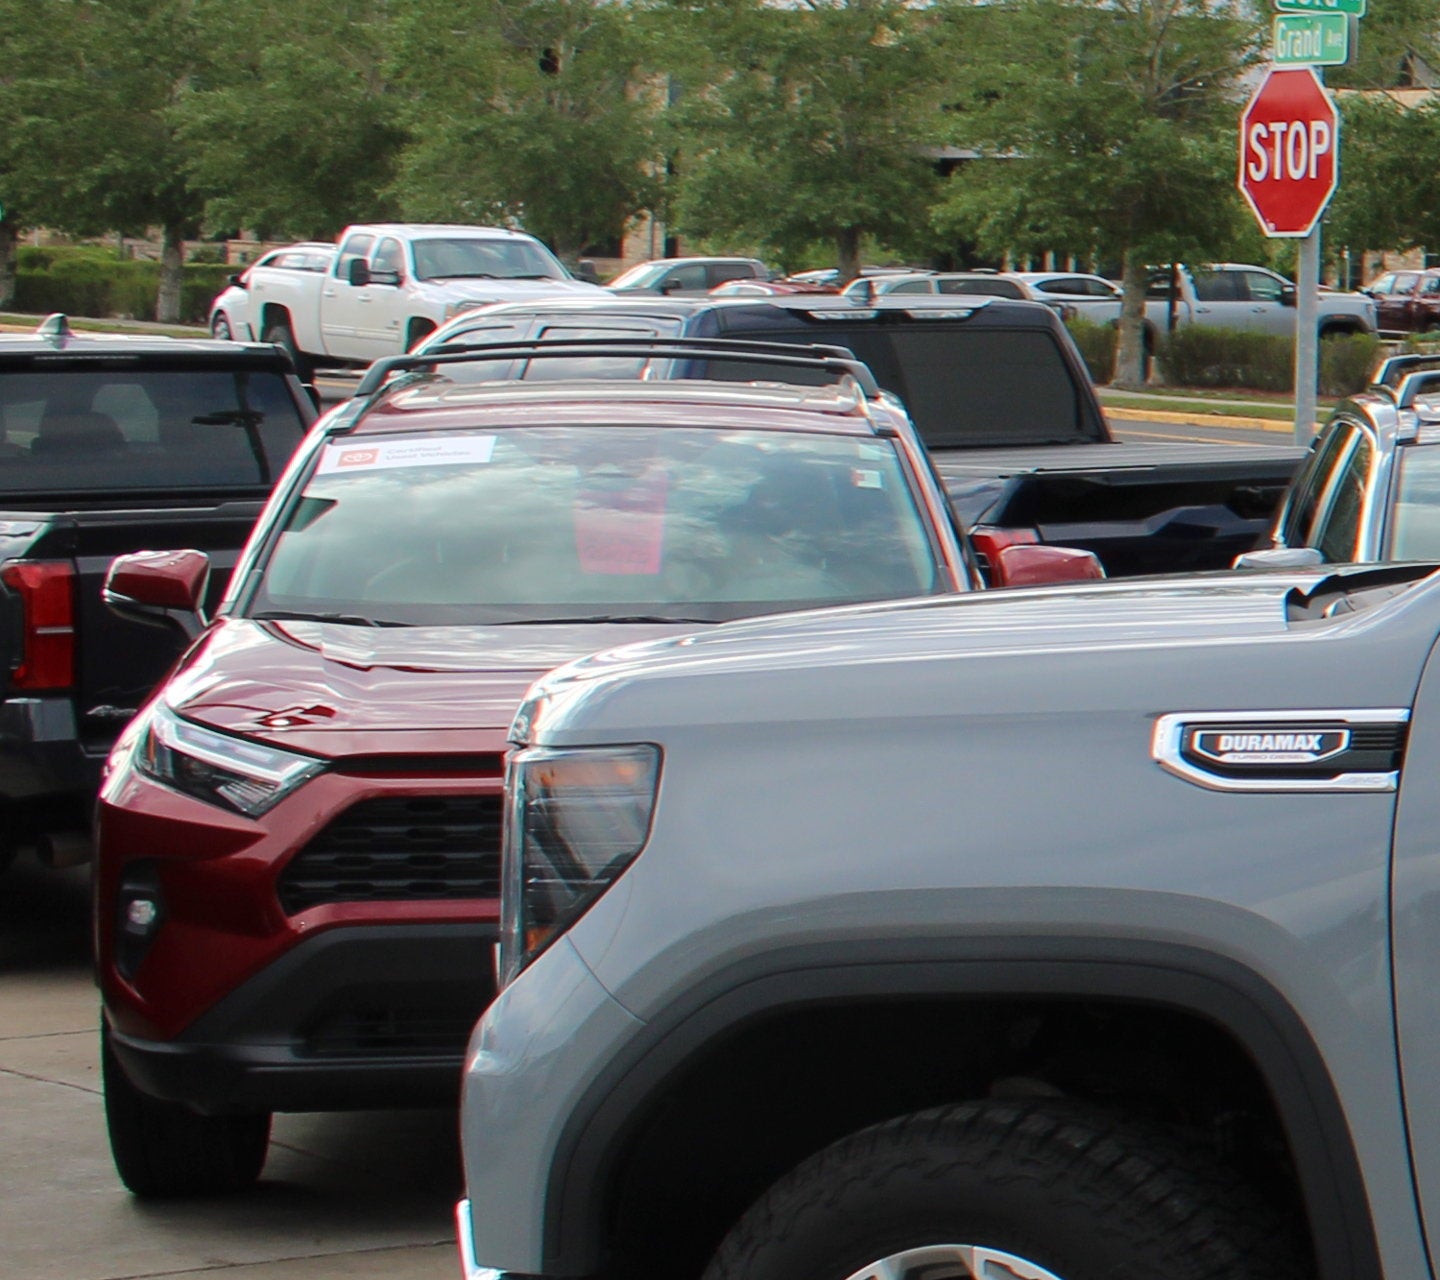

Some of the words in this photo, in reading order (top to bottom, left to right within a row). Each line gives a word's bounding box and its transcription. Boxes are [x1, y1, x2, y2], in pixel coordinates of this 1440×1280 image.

[1276, 21, 1322, 59] Grand
[1247, 120, 1331, 182] STOP
[1218, 734, 1323, 751] DURAMAX
